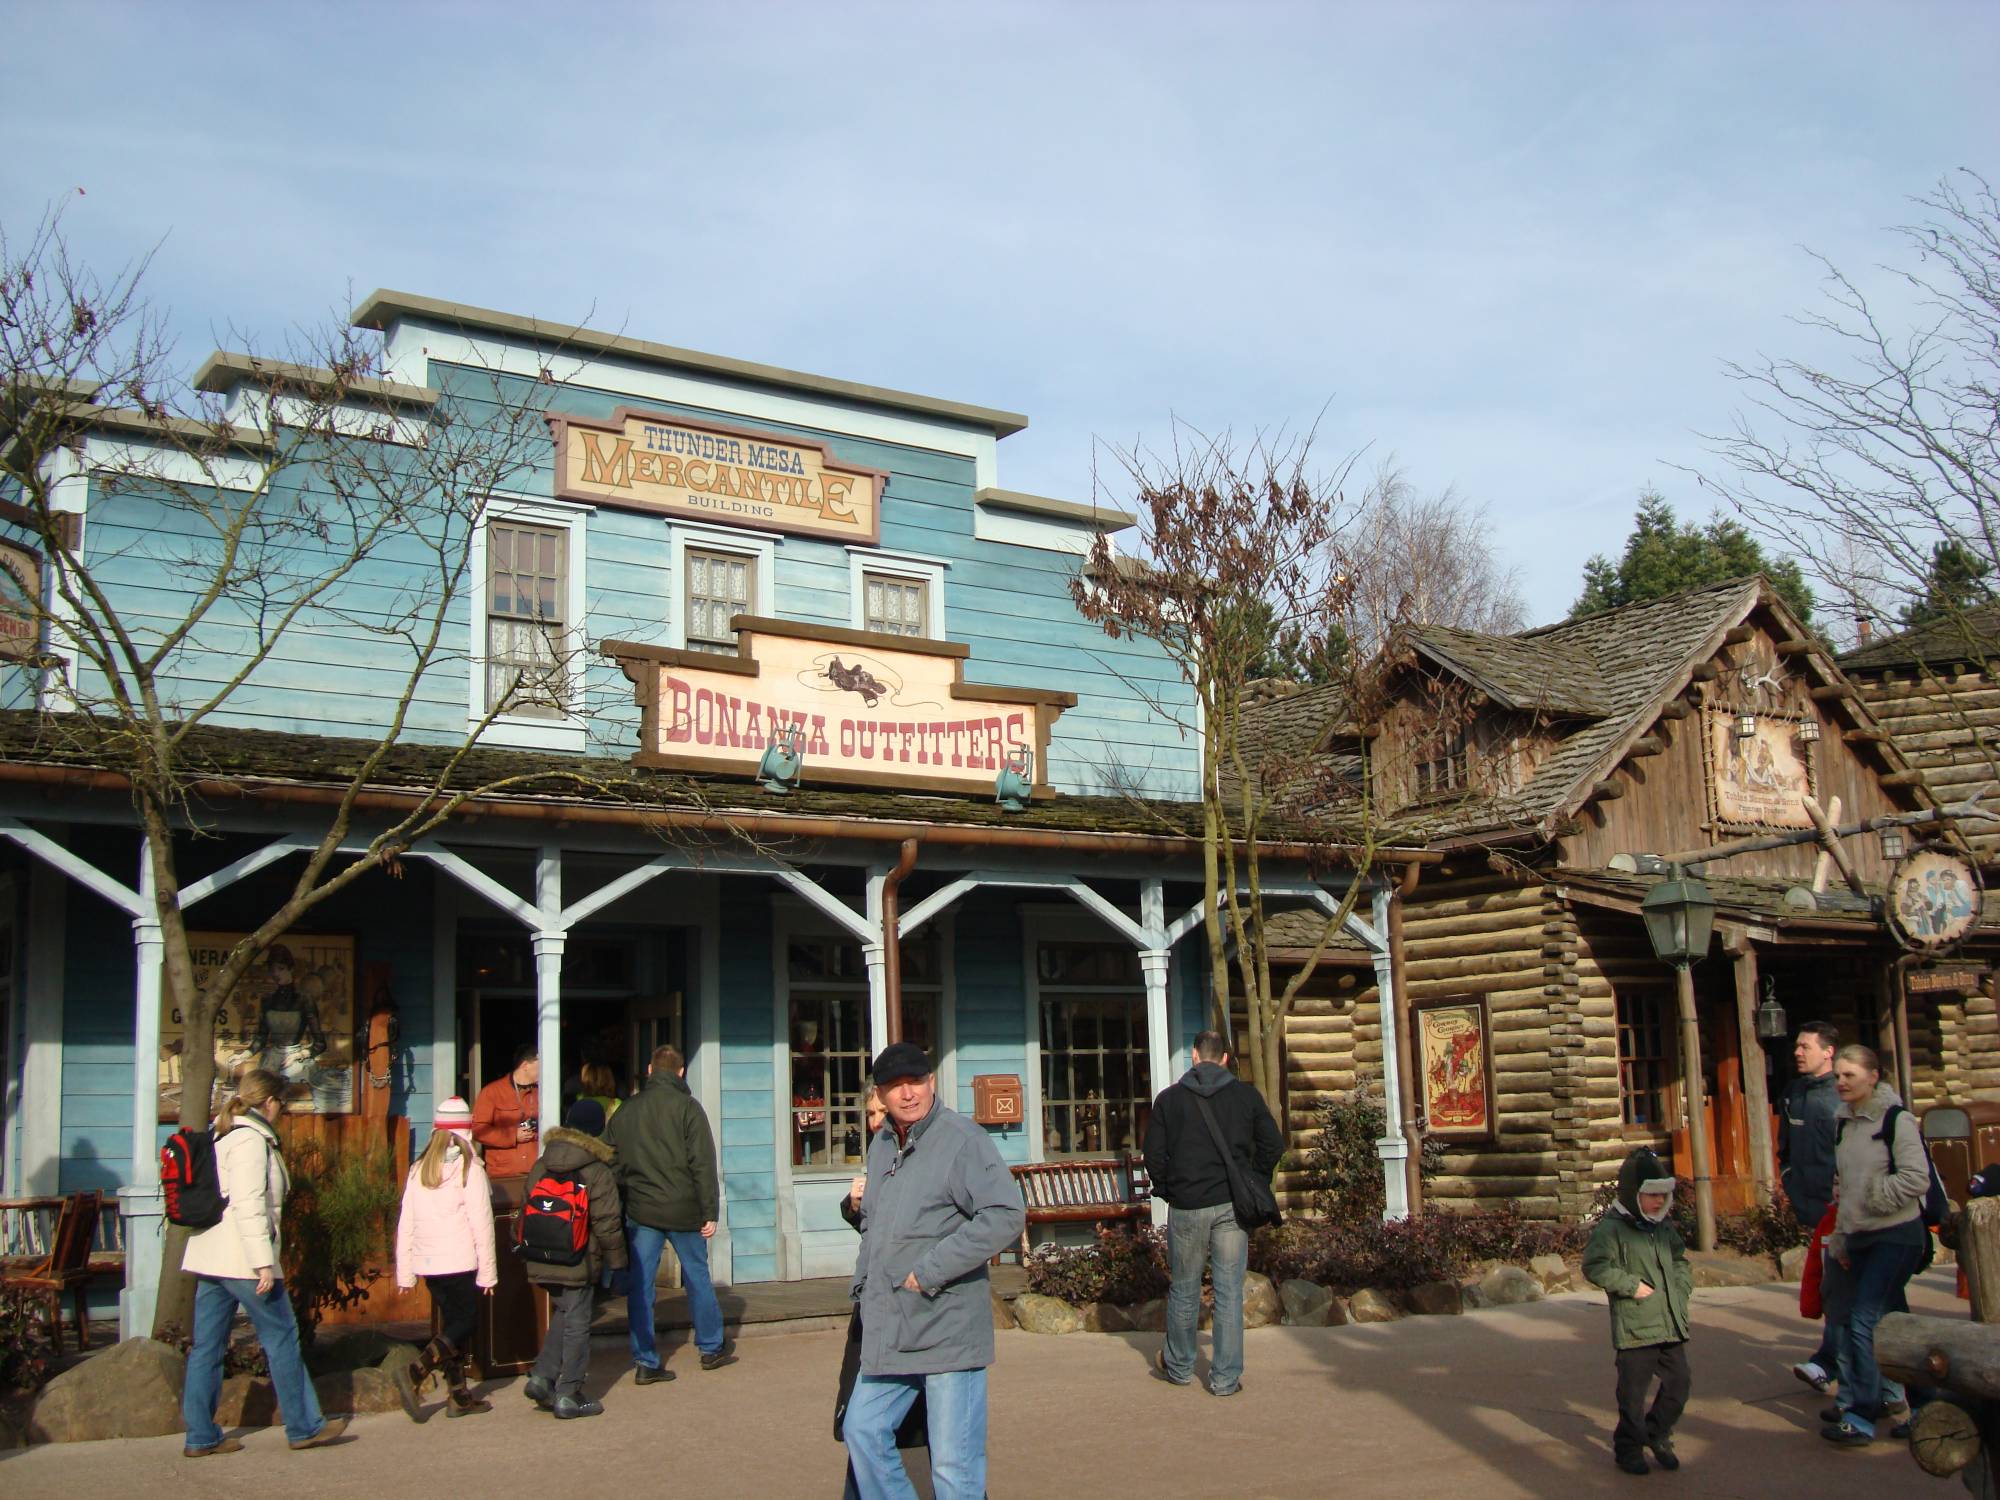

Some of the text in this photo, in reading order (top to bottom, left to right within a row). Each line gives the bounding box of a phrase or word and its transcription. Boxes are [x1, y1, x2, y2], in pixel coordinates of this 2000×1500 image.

[579, 430, 860, 525] MERCANTILE
[643, 425, 805, 476] THUNDER MESA
[687, 494, 774, 518] BUILDING
[666, 676, 1025, 774] BONANZA OUTFITTERS
